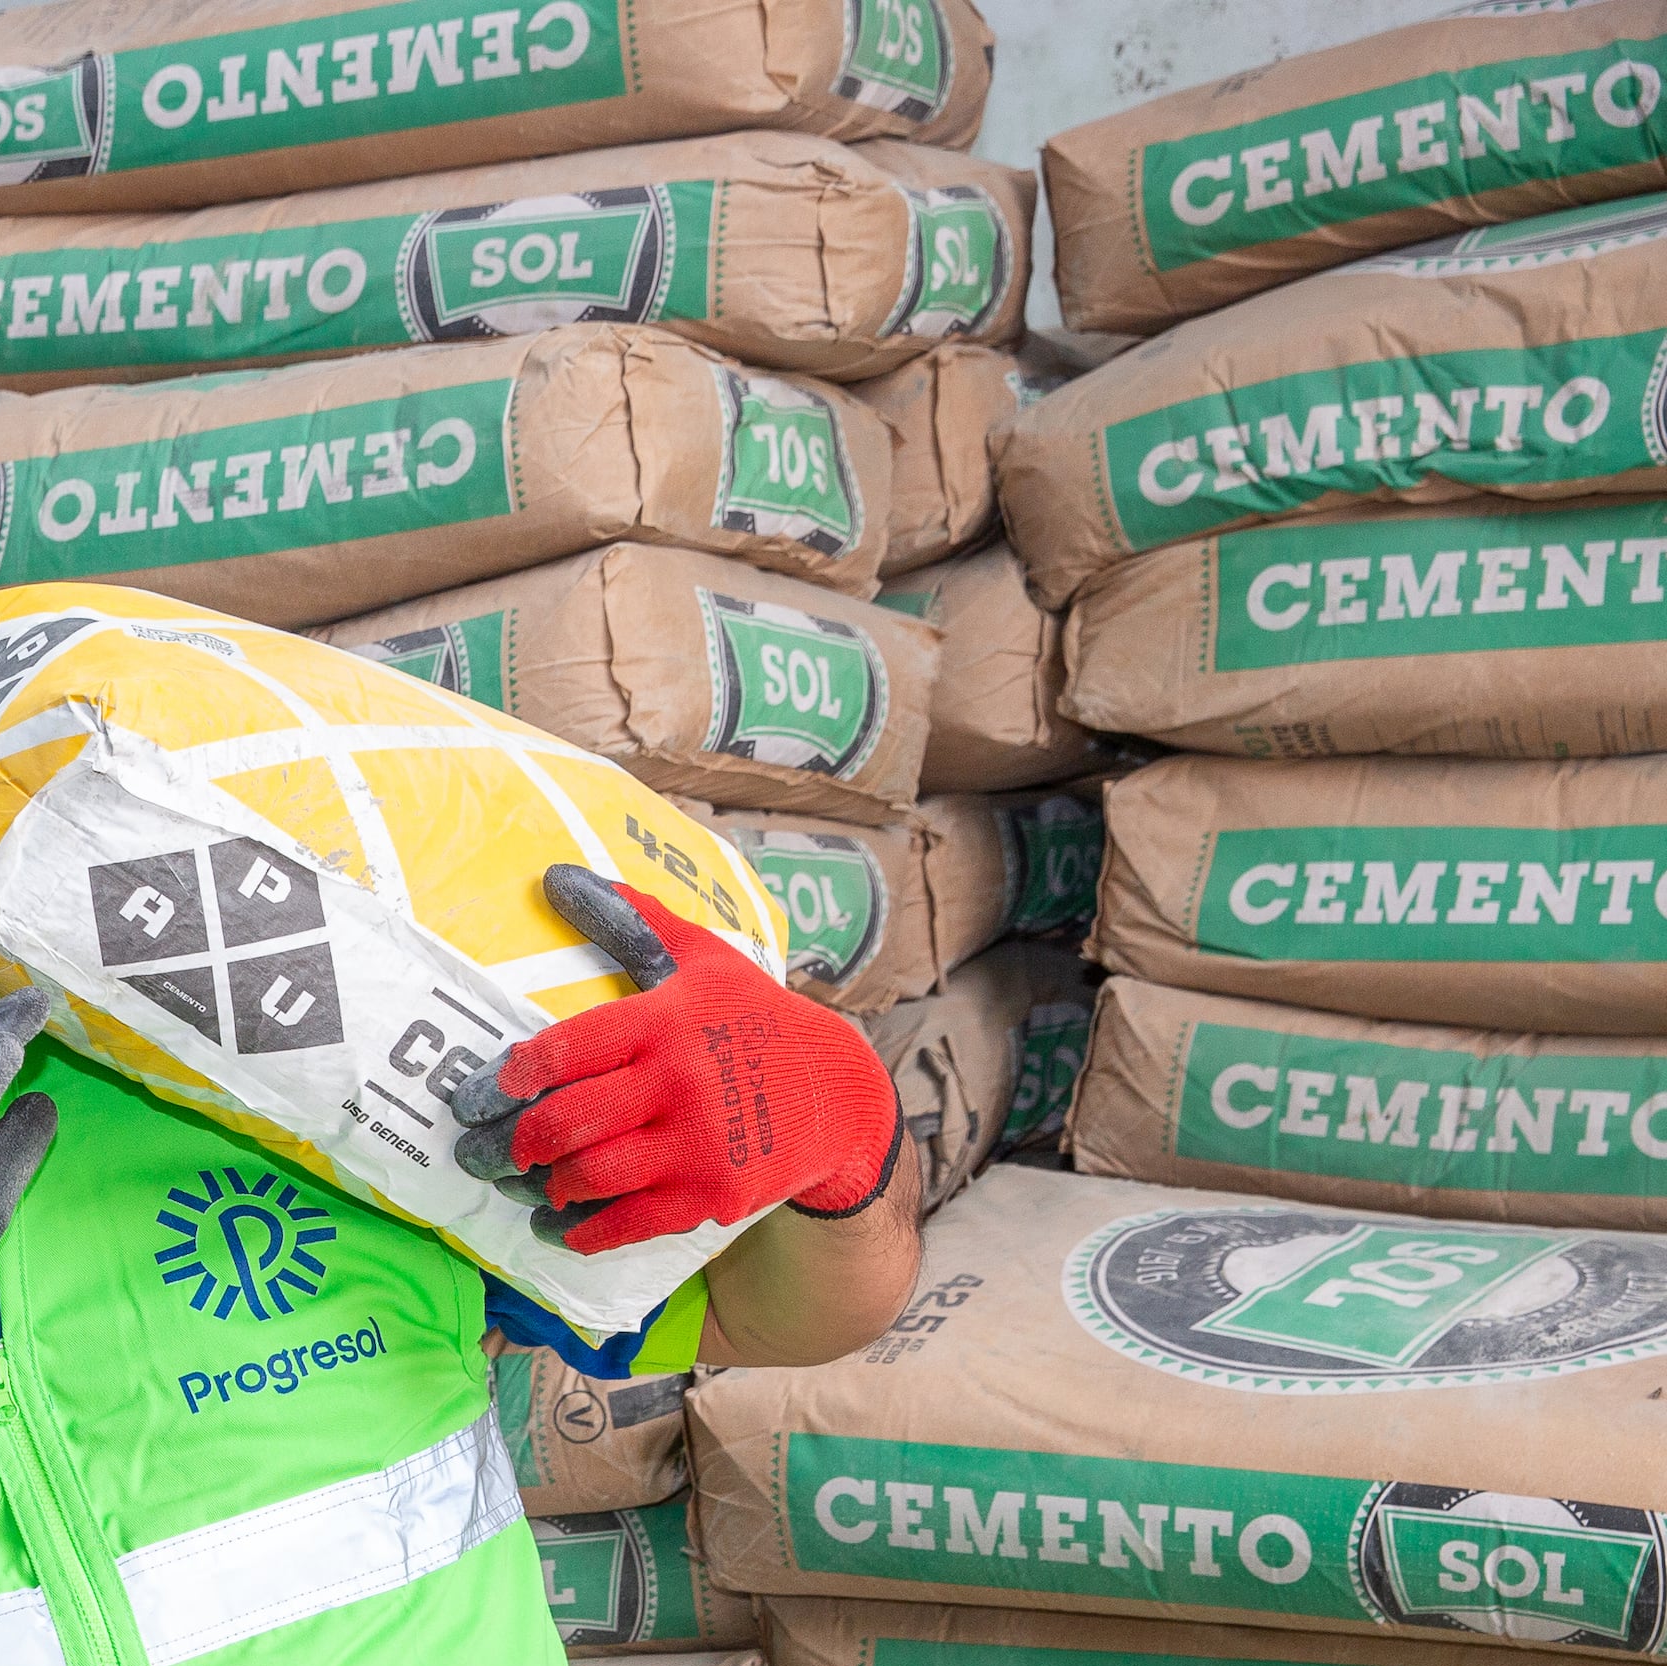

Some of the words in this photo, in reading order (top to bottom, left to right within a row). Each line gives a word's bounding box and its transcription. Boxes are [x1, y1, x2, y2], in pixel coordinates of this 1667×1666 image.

[141, 0, 591, 130] CEMENTO
[1169, 60, 1662, 227] CEMENTO
[469, 230, 591, 285] SOL
[36, 416, 478, 541] CEMENTO
[750, 425, 831, 490] SOL
[1138, 376, 1610, 507] CEMENTO
[1247, 535, 1667, 631] CEMENT
[759, 642, 844, 722] SOL
[625, 813, 742, 932] 42.5
[1229, 860, 1667, 926] CEMENT
[163, 981, 206, 1013] CEMENTO
[342, 1098, 369, 1124] USO
[370, 1121, 431, 1169] GENERAL
[1305, 1241, 1498, 1307] SOL
[178, 1316, 387, 1414] Progresol
[814, 1477, 1312, 1585] CEMENTO
[1437, 1541, 1585, 1607] SOL
